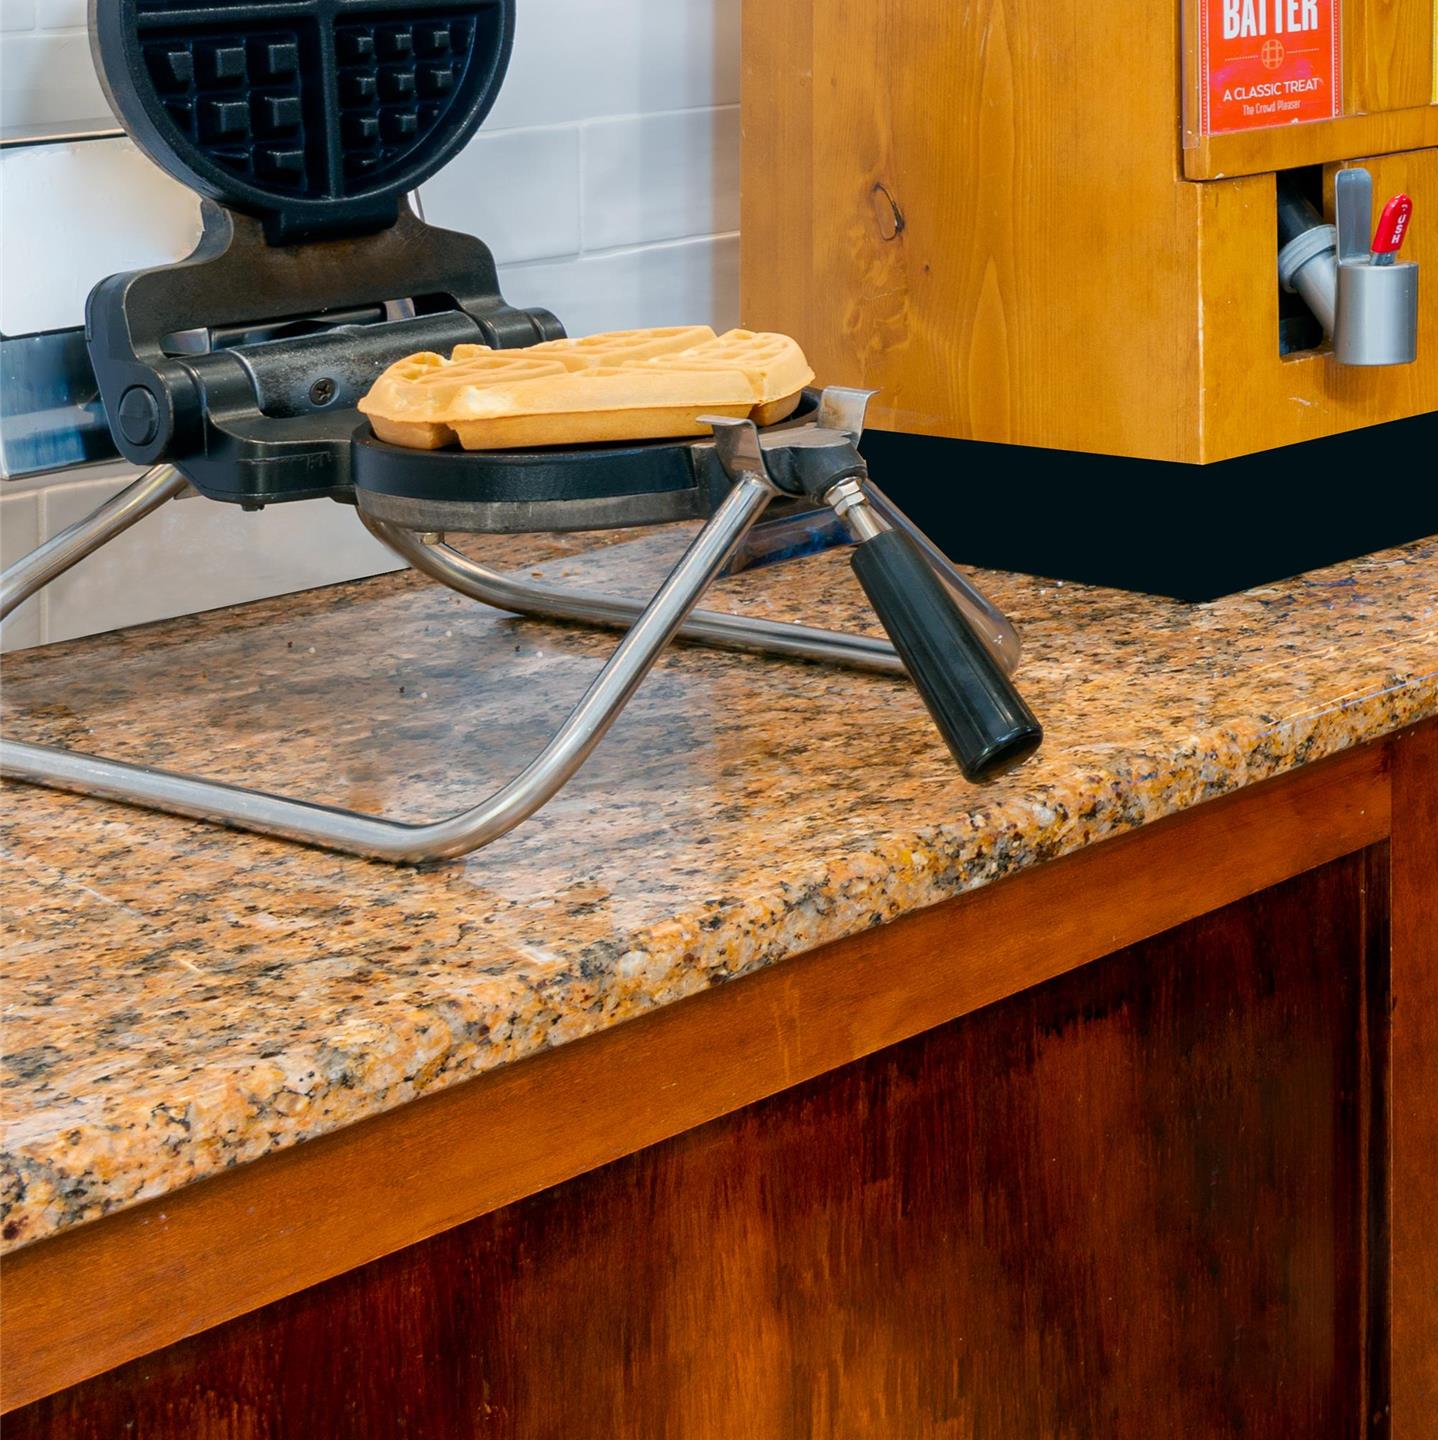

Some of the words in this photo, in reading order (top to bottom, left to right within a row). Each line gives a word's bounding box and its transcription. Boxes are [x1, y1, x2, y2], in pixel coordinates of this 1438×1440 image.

[1223, 89, 1232, 102] A
[1234, 82, 1281, 100] CLASSIC
[1283, 77, 1320, 93] TREAT
[1243, 104, 1254, 116] The
[1256, 100, 1276, 114] Crowd
[1277, 99, 1301, 112] Pleaser
